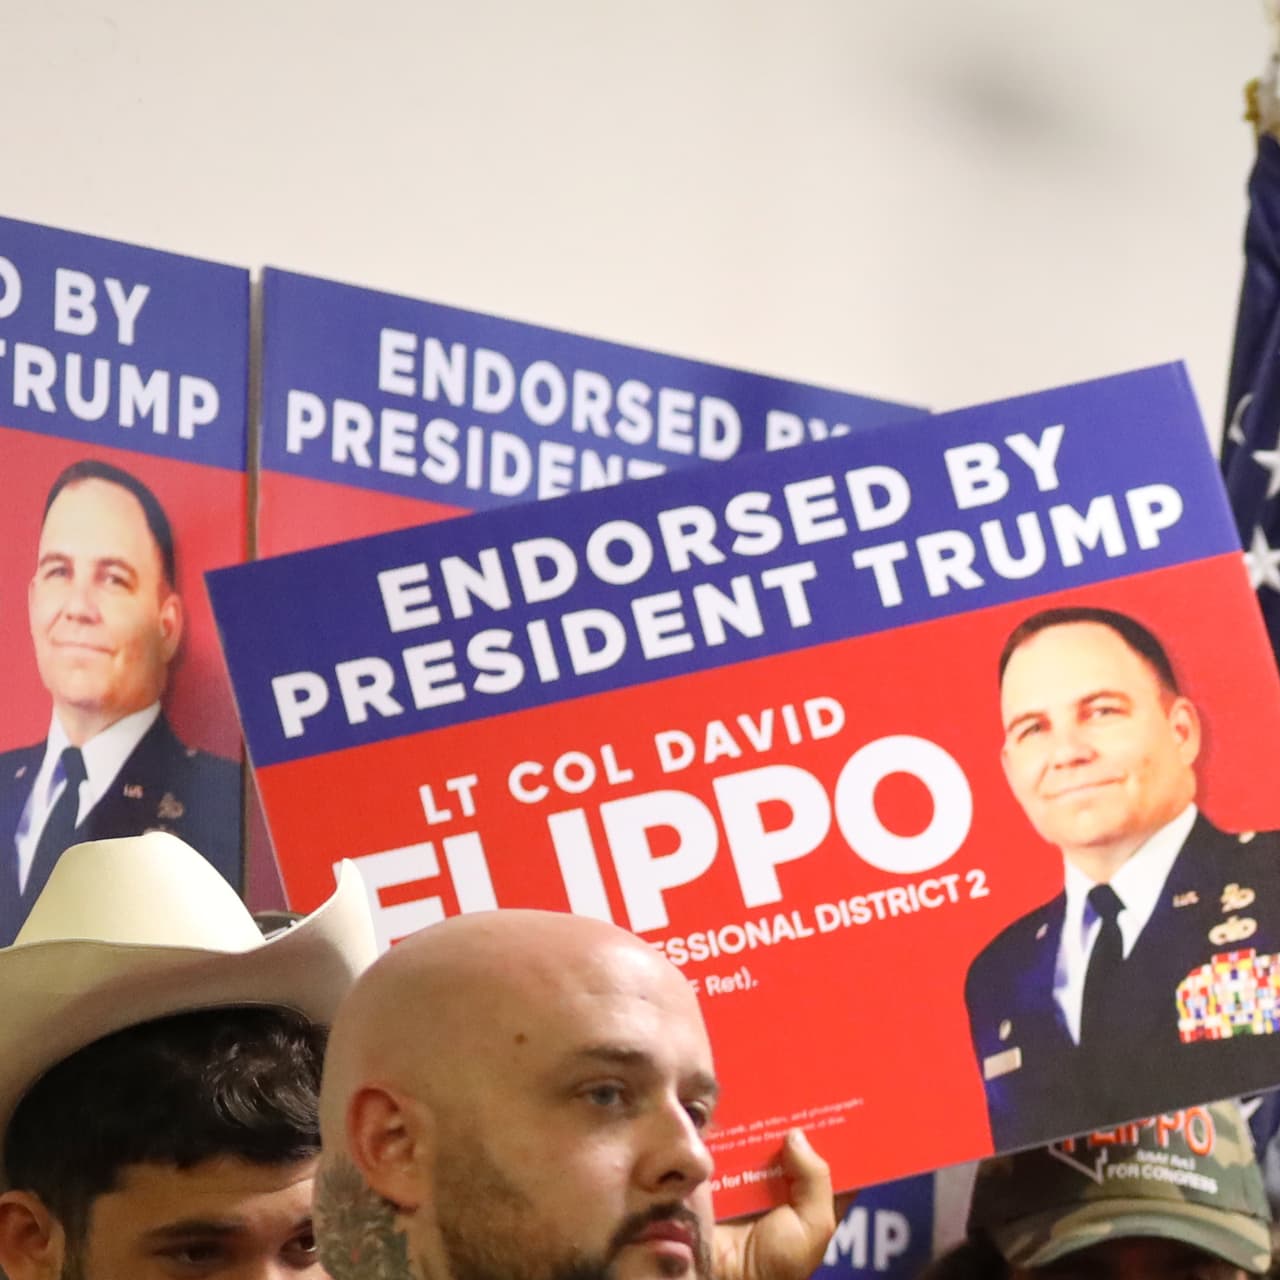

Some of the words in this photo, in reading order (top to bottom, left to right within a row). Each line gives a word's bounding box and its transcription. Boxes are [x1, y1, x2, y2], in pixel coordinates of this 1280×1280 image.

[54, 266, 150, 347] BY
[0, 338, 220, 440] RUMP
[285, 389, 668, 501] PRESIDEN
[377, 326, 743, 462] ENDORSED
[376, 464, 912, 634] ENDORSED
[942, 423, 1066, 511] BY
[270, 559, 818, 739] PRESIDENT
[851, 482, 1185, 609] TRUMP
[418, 773, 479, 825] LT
[507, 743, 635, 804] COL
[653, 696, 846, 774] DAVID
[653, 911, 815, 966] SSIONAL
[813, 872, 961, 934] DISTRICT
[964, 868, 991, 900] 2
